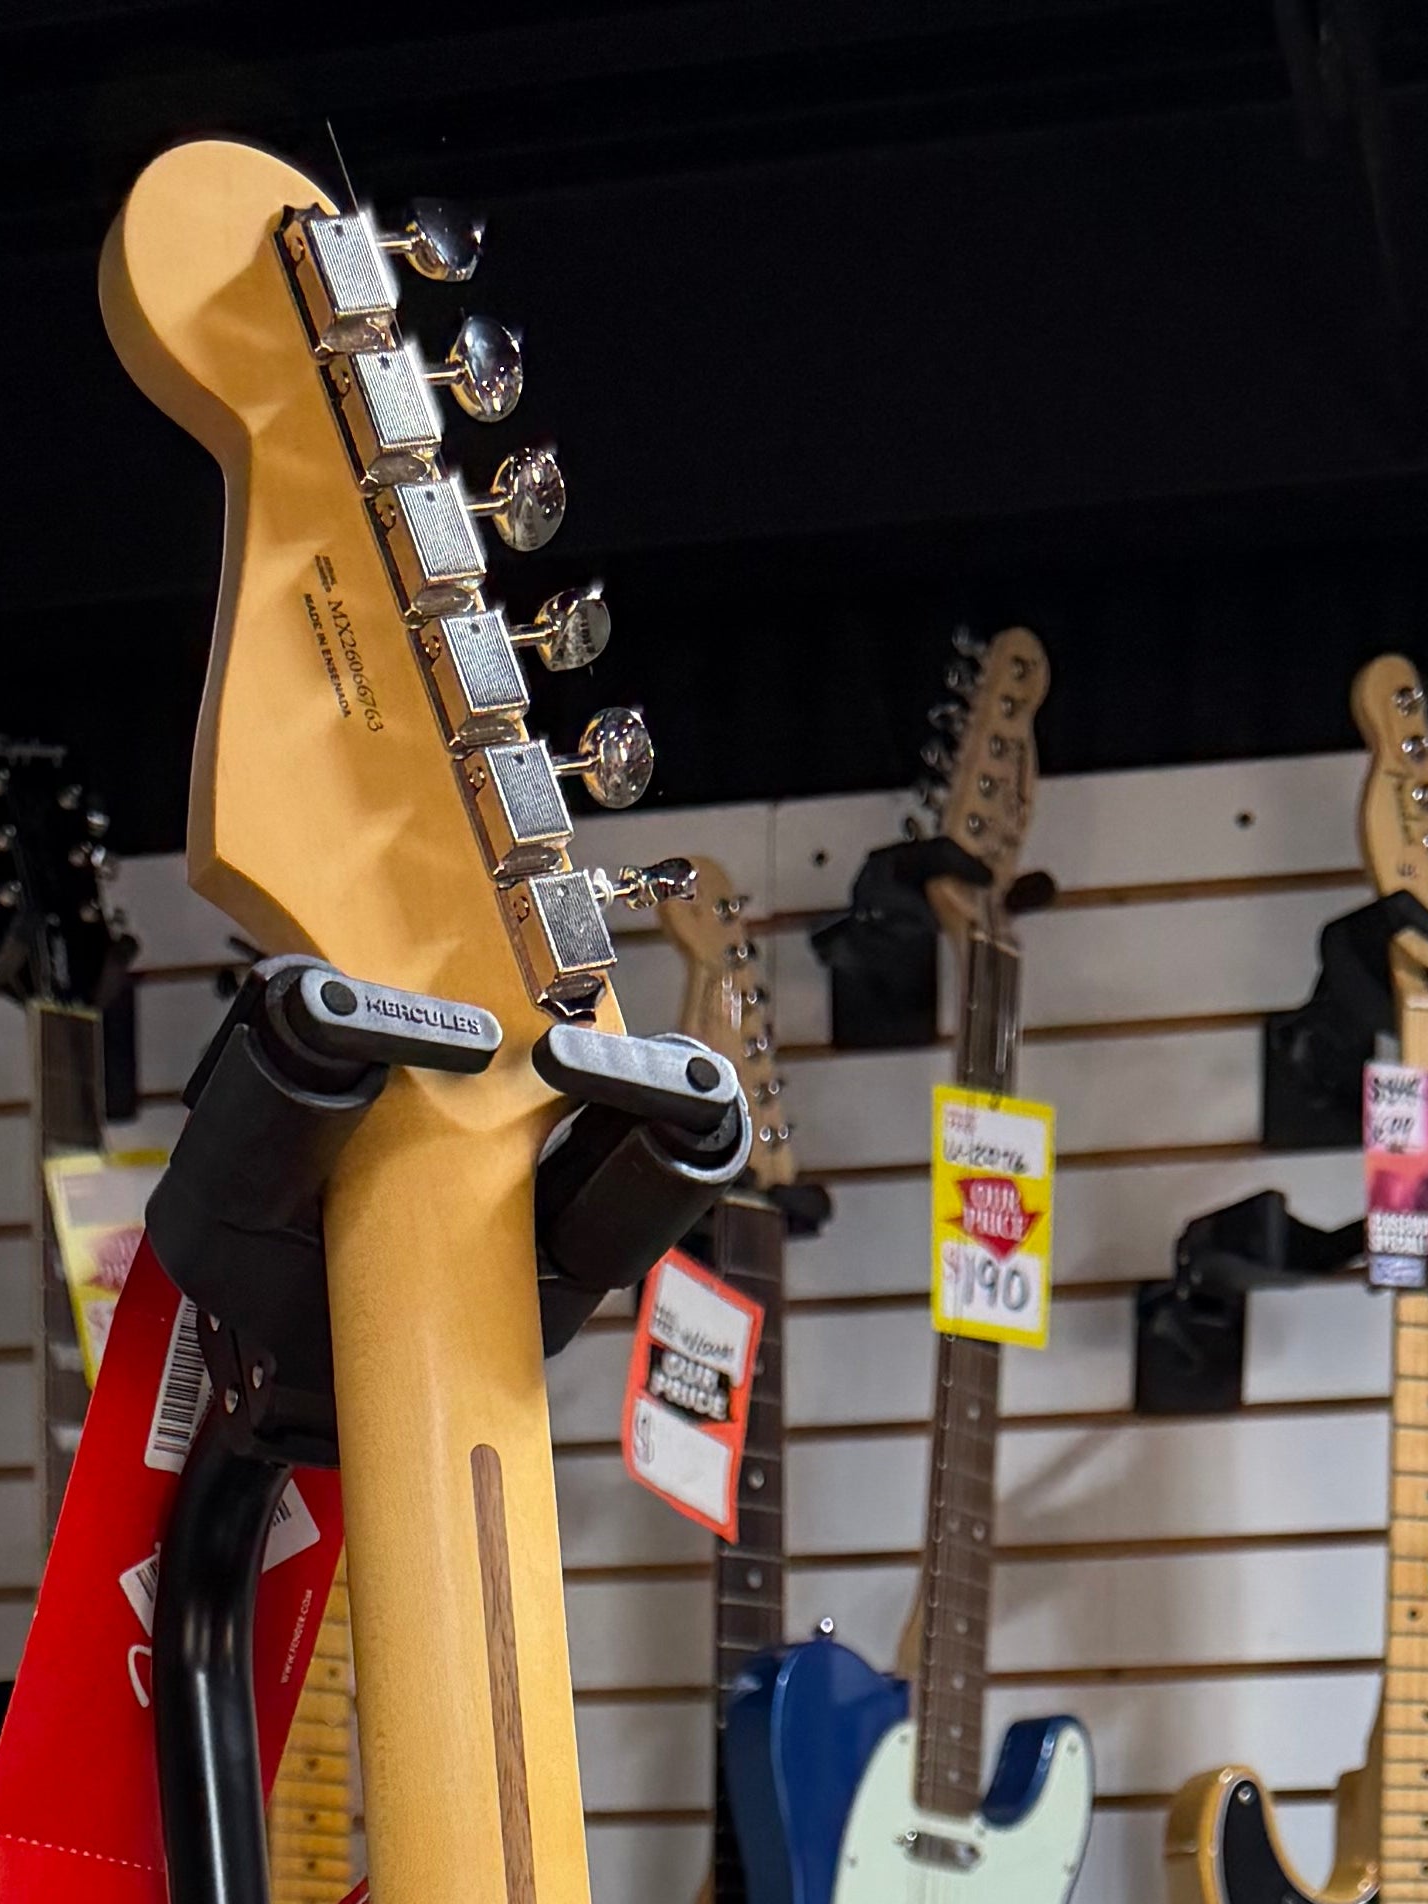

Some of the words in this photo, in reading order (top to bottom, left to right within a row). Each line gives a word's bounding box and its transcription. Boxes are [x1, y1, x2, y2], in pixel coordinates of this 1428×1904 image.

[304, 593, 323, 630] MADE
[316, 632, 328, 646] IN
[321, 648, 352, 719] ENSENADA
[328, 599, 385, 732] MX26066763
[365, 995, 481, 1035] HERCULES
[279, 1588, 313, 1685] WWW.FENDER.COM
